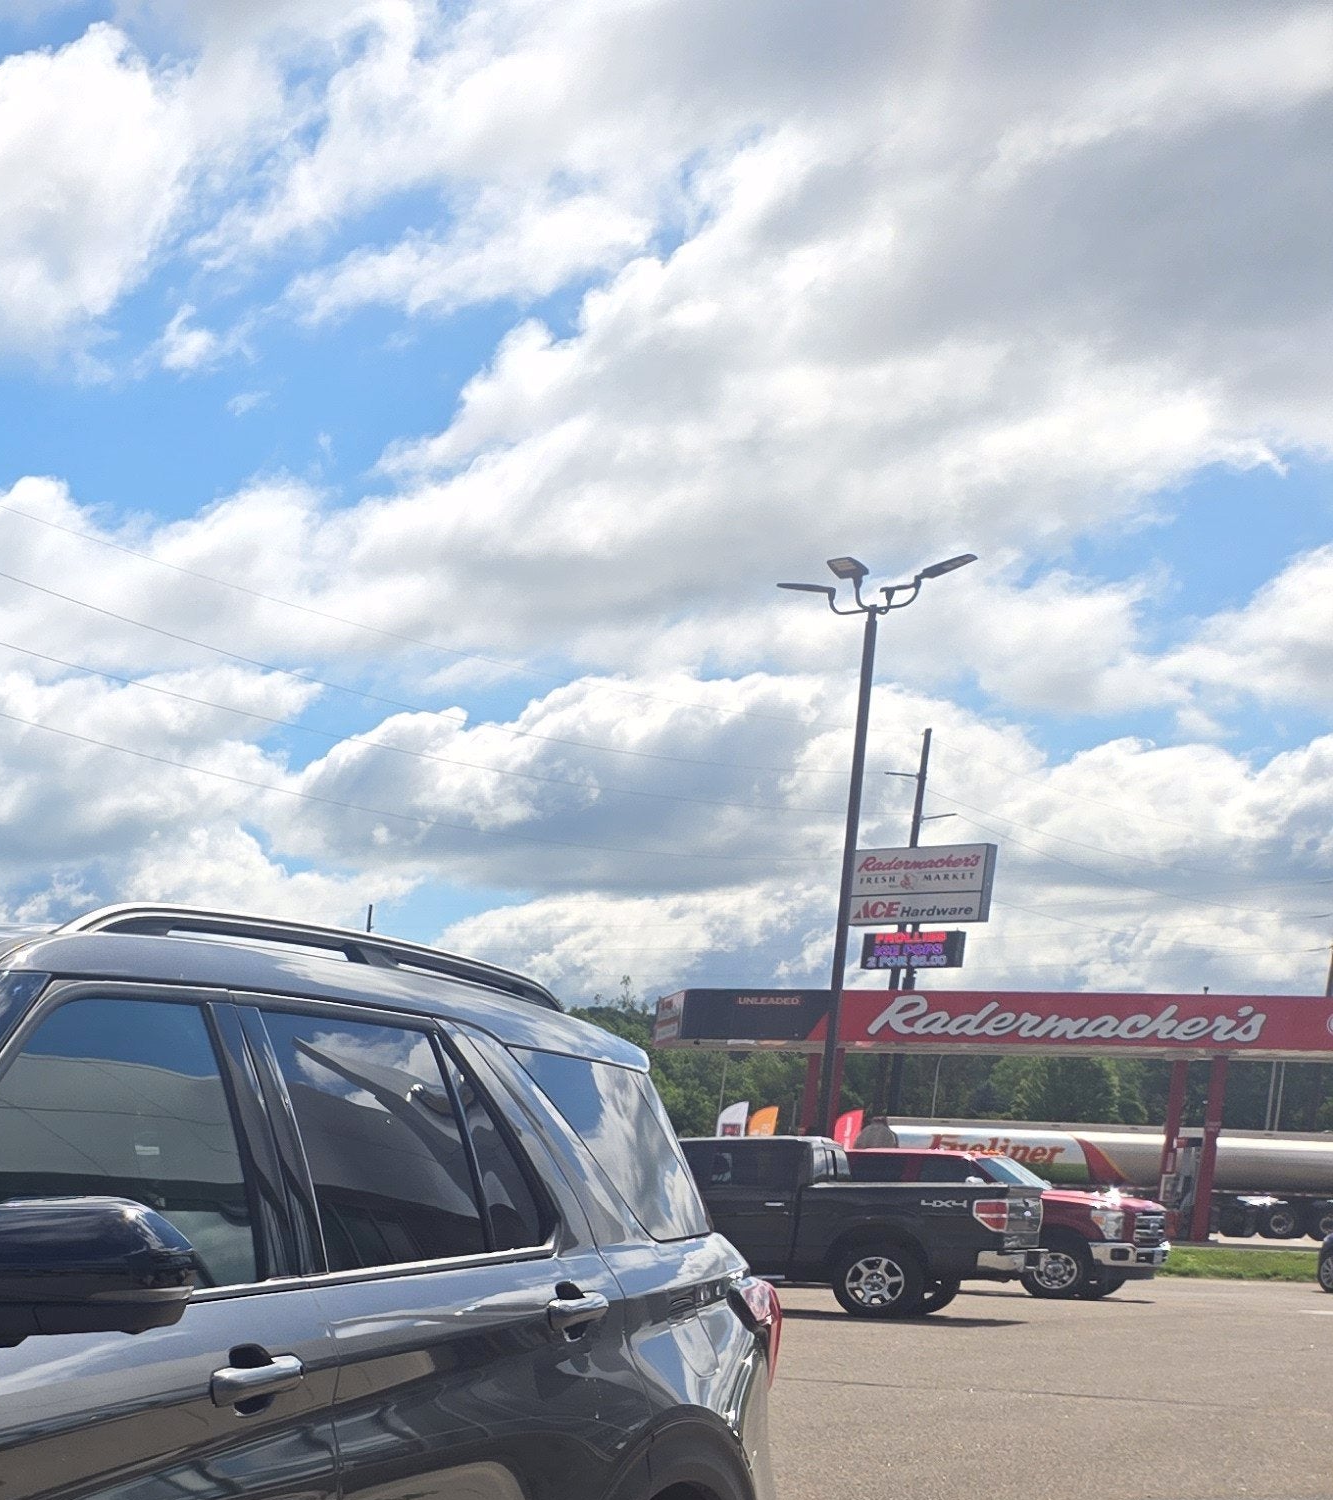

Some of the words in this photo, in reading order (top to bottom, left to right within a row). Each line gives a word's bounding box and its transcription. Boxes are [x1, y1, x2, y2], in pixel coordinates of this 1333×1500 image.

[857, 854, 981, 872] Radermacher's
[860, 875, 896, 884] FRESH
[923, 872, 975, 881] MARKET
[853, 900, 901, 919] ACE
[900, 906, 973, 918] Hardware
[738, 997, 800, 1005] UNLEADED
[867, 995, 1266, 1042] Radermacher's
